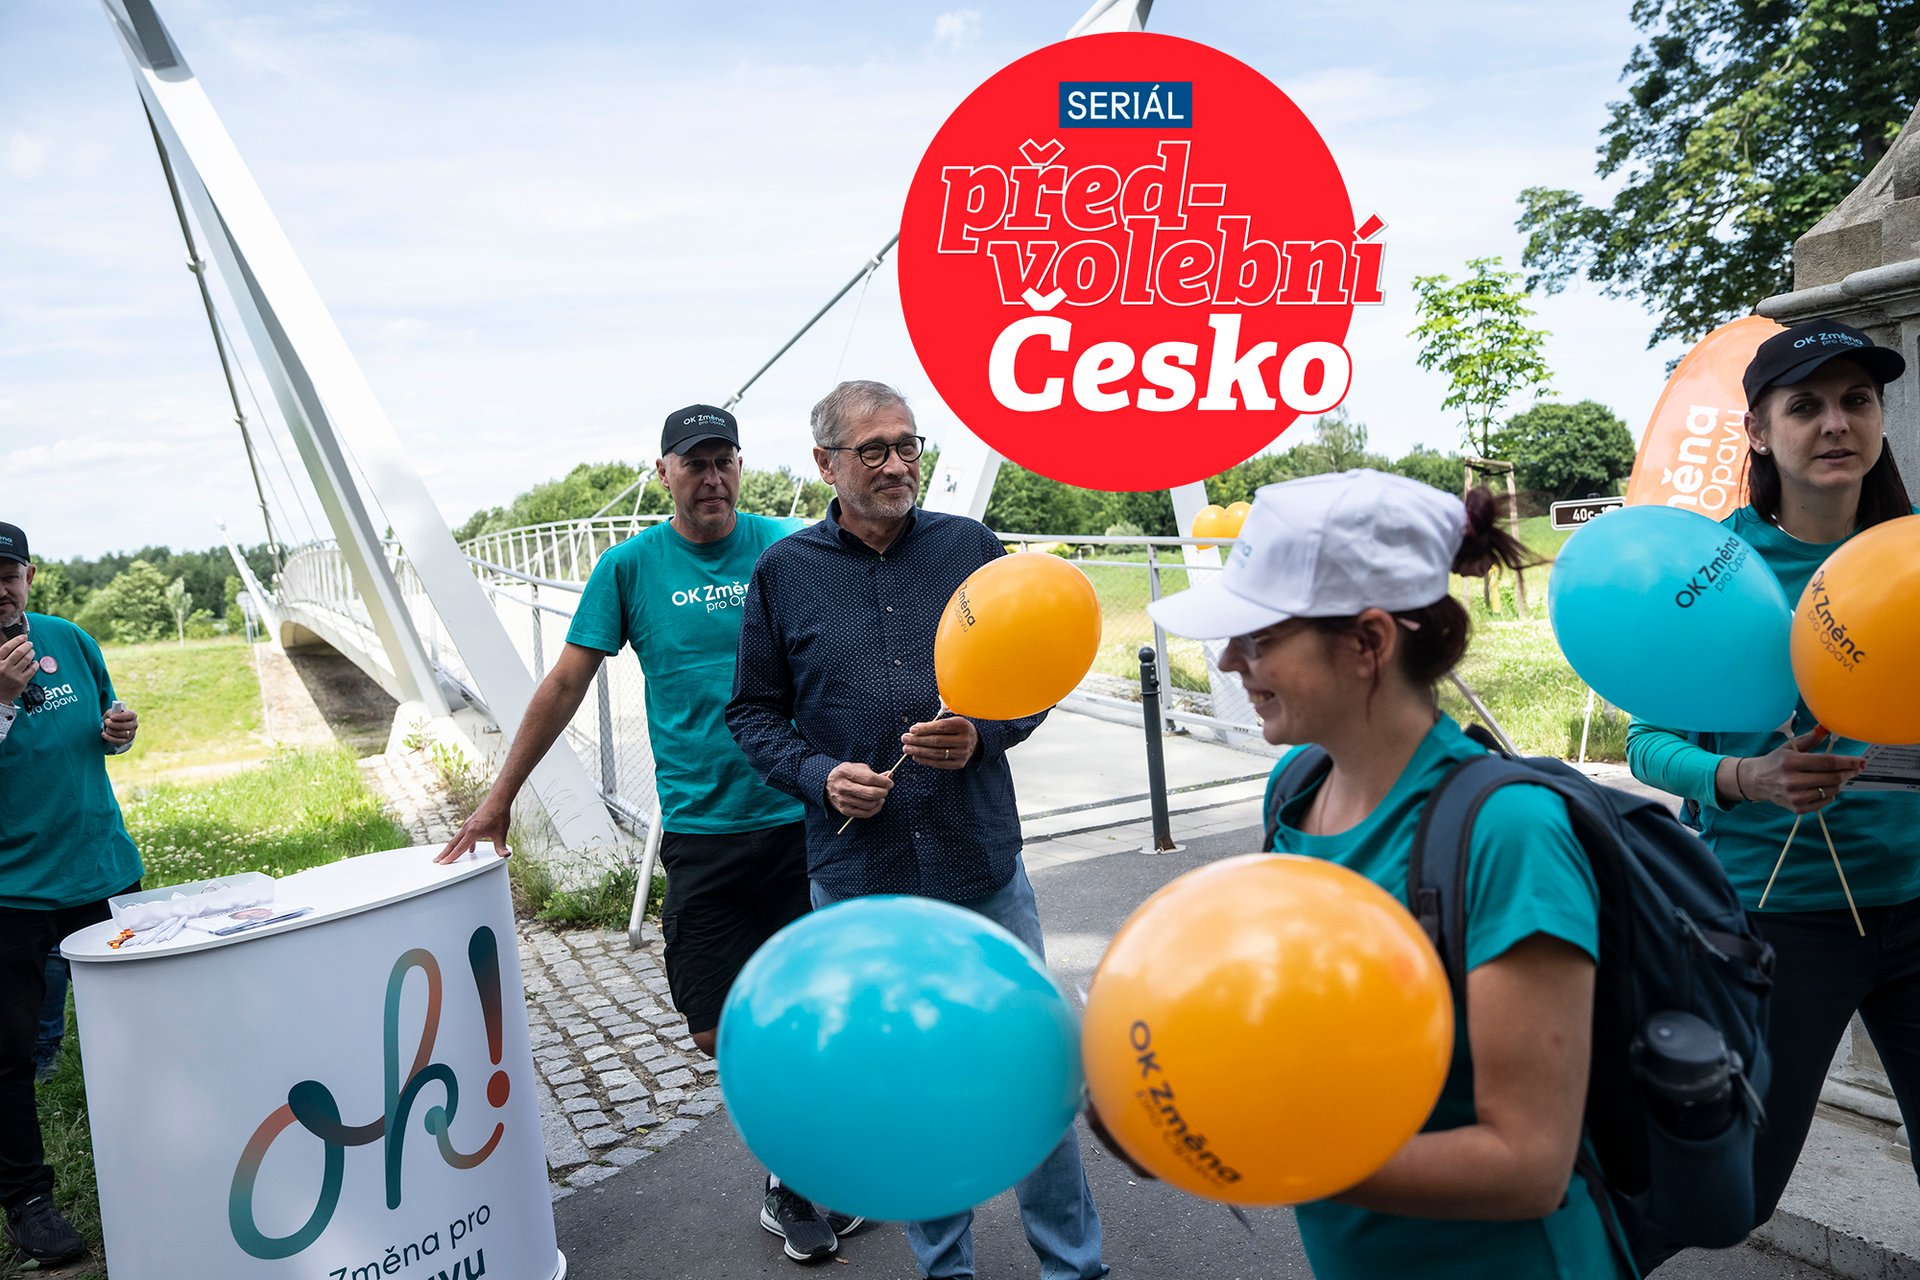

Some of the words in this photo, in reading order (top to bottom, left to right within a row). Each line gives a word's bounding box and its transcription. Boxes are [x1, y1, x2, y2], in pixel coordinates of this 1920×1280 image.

[1793, 335, 1816, 348] OK
[1818, 332, 1864, 346] Změna
[683, 416, 696, 425] OK
[1699, 408, 1746, 511] Opavu
[1675, 577, 1708, 608] OK
[1698, 536, 1740, 583] Změna
[1714, 572, 1732, 593] pro
[672, 587, 702, 606] OK
[706, 600, 727, 614] pro
[42, 683, 73, 701] ěna
[42, 694, 78, 711] Opavu
[229, 925, 511, 1260] ok!
[1130, 1020, 1163, 1078] OK
[1149, 1080, 1242, 1184] Změna
[449, 1204, 491, 1250] pro
